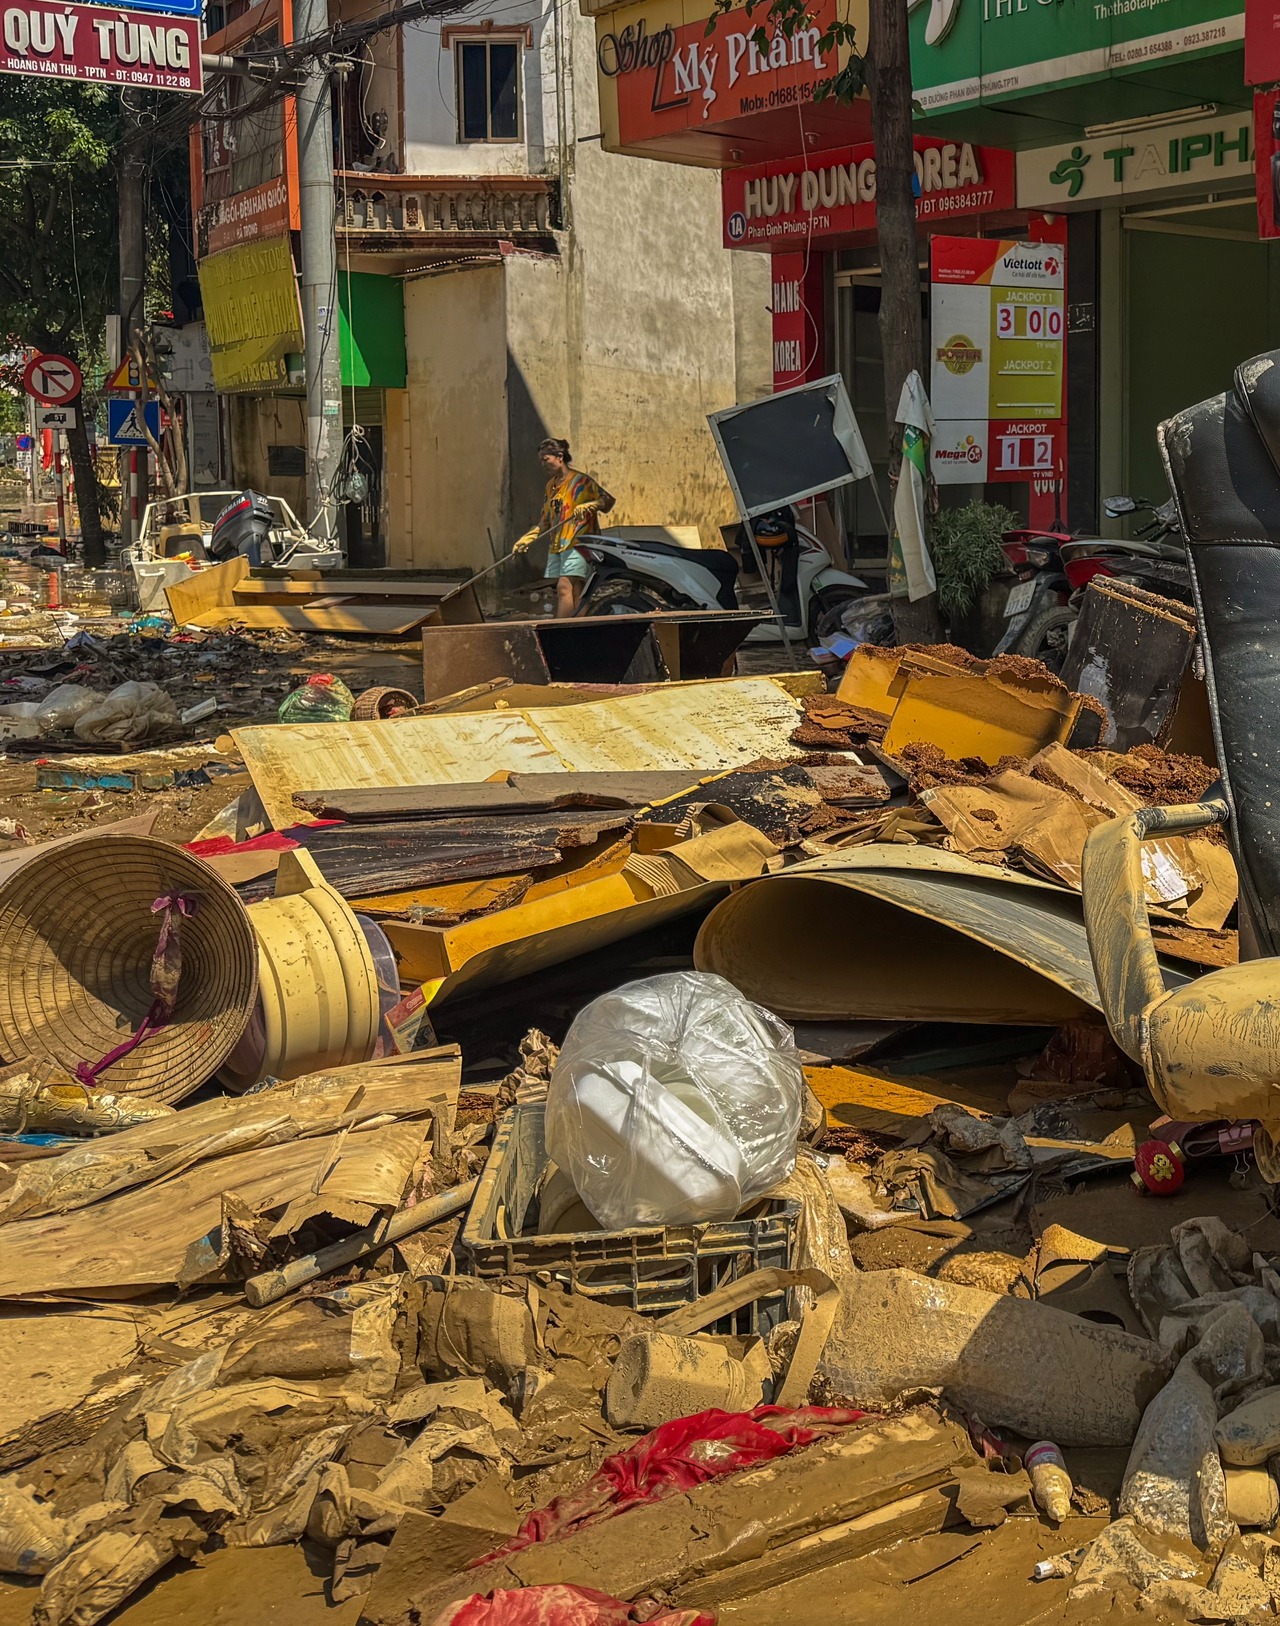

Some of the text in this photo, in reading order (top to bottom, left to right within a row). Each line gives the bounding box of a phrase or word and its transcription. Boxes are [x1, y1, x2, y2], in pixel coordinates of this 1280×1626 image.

[4, 7, 190, 69] QUÝ TÙNG
[599, 18, 690, 112] Shop
[1111, 52, 1126, 63] TEL:
[40, 60, 58, 74] VĂN
[59, 63, 76, 78] THỤ
[84, 66, 106, 78] TPTN
[132, 72, 153, 84] 0947
[156, 75, 164, 85] 11
[166, 76, 178, 86] 22
[180, 78, 190, 88] 88
[673, 44, 719, 119] Mỹ
[950, 88, 966, 101] PHAN
[744, 143, 980, 219] HUY DUNG OREA
[748, 225, 766, 238] Phan
[766, 221, 782, 236] Đình
[939, 190, 994, 212] 0963843777
[730, 217, 742, 236] 1A
[1004, 258, 1042, 270] Vietlott
[774, 275, 800, 314] HÀNG
[1006, 292, 1052, 302] JACKPOT 1
[774, 340, 800, 372] KOREA
[1004, 361, 1052, 370] JACKPOT 2
[54, 414, 64, 422] 5T
[1006, 424, 1047, 434] JACKPOT
[935, 450, 966, 460] Mega
